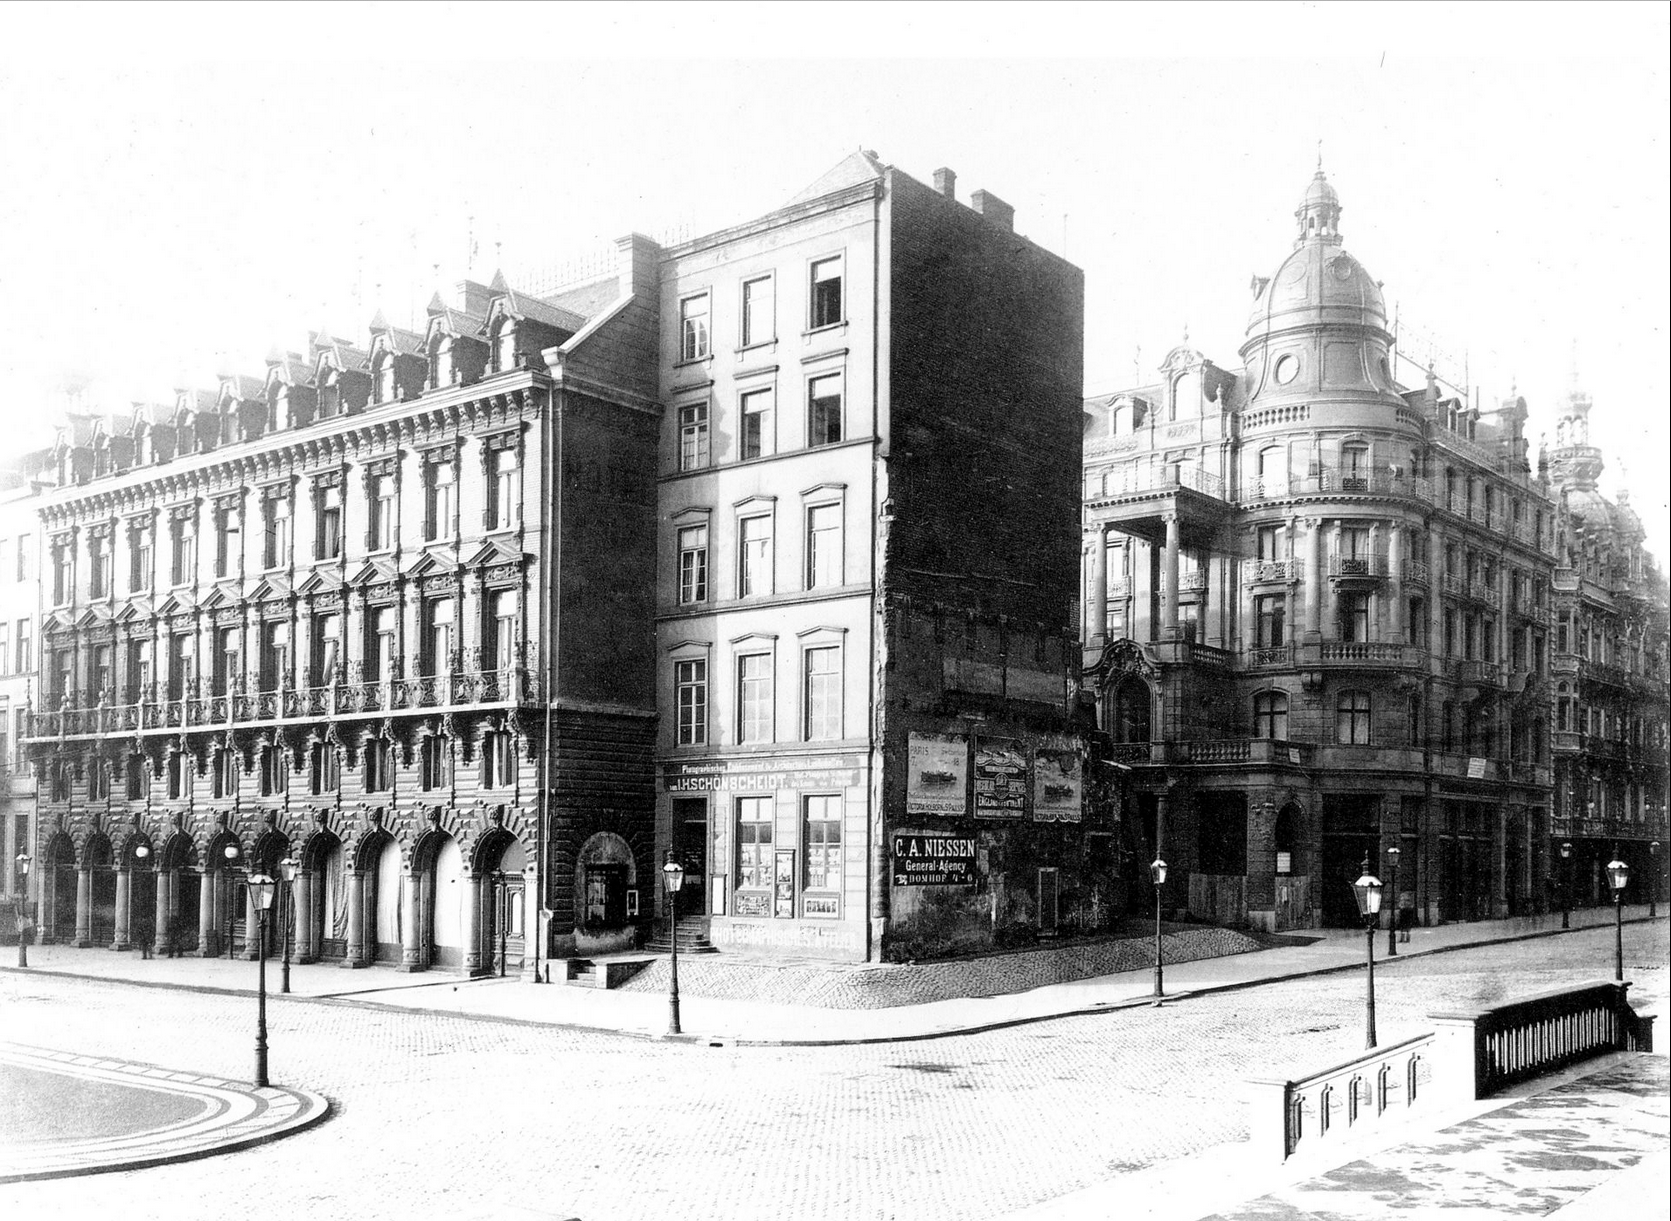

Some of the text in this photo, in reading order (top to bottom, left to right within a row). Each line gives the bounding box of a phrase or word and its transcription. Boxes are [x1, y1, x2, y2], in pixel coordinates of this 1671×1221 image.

[910, 745, 929, 756] PARIS
[895, 838, 975, 857] C. A. NIESSEN
[909, 874, 948, 883] DOMHOF
